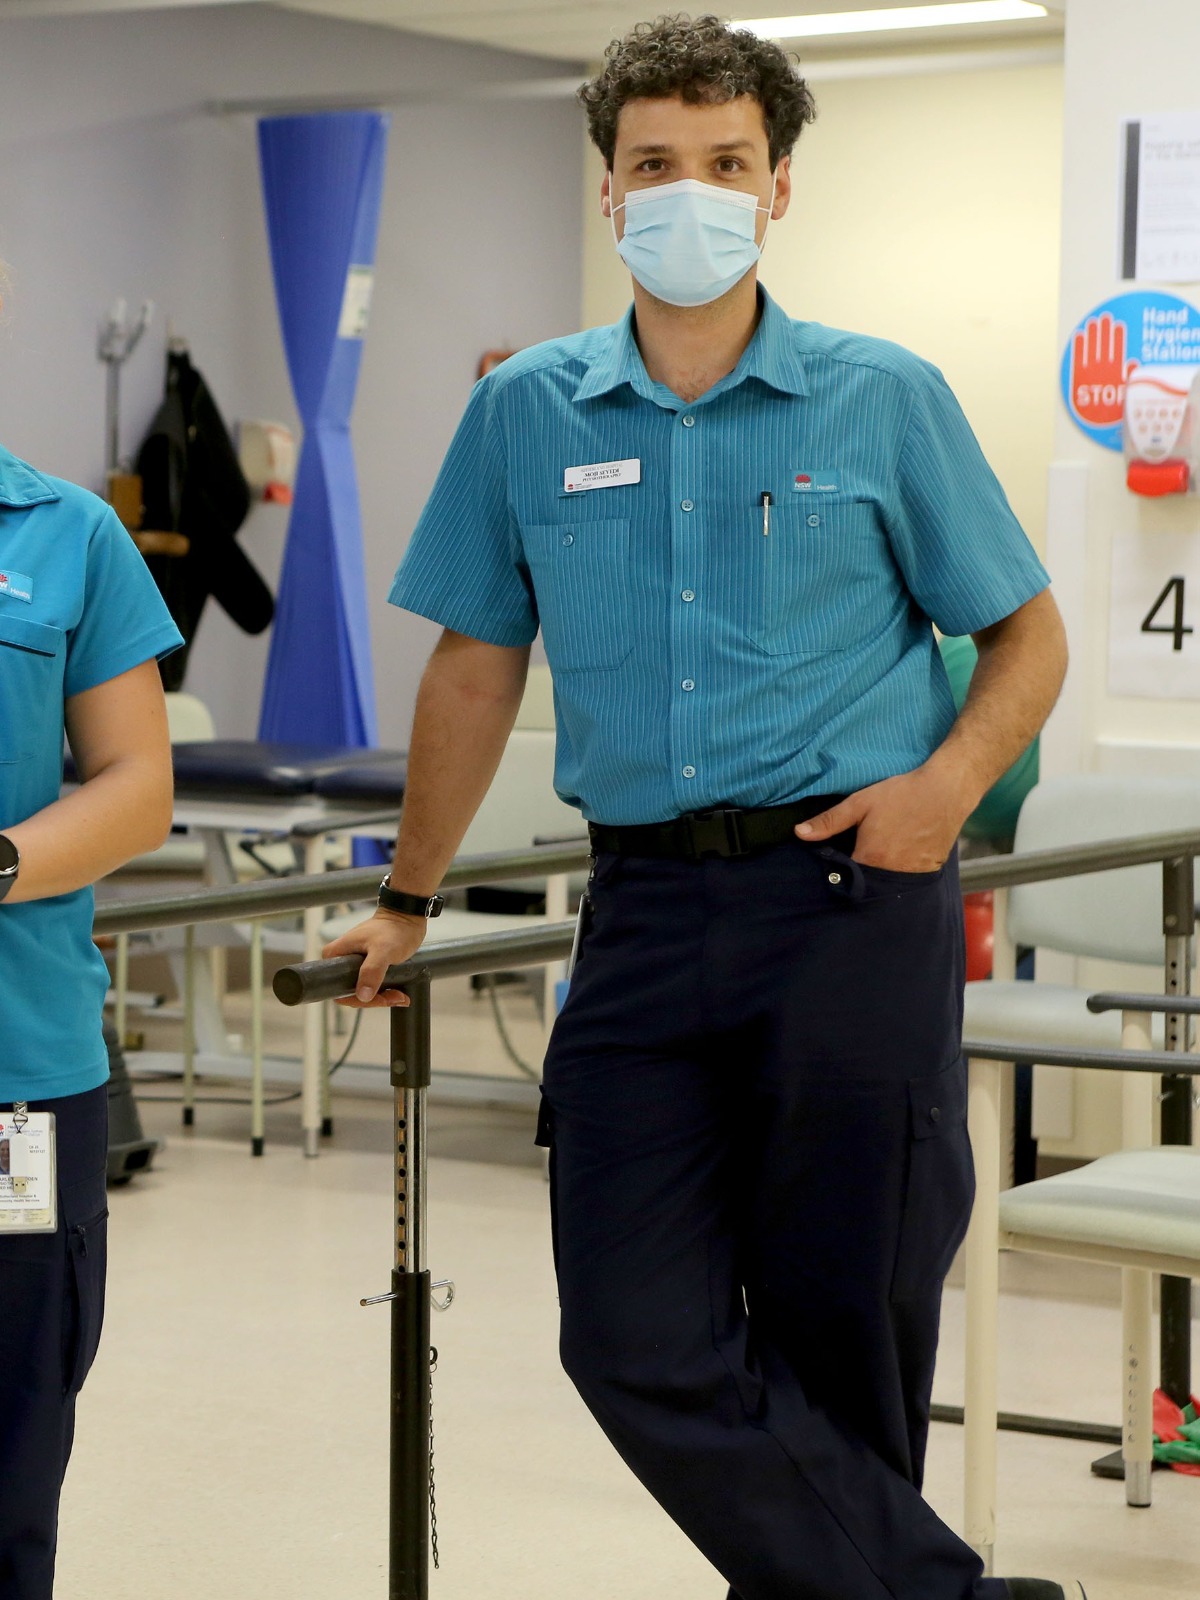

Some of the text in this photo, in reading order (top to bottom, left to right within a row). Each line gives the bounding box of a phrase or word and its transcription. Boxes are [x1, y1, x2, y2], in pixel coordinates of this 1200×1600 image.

[1142, 306, 1188, 325] Hand
[10, 587, 31, 600] Health
[1140, 574, 1194, 652] 4
